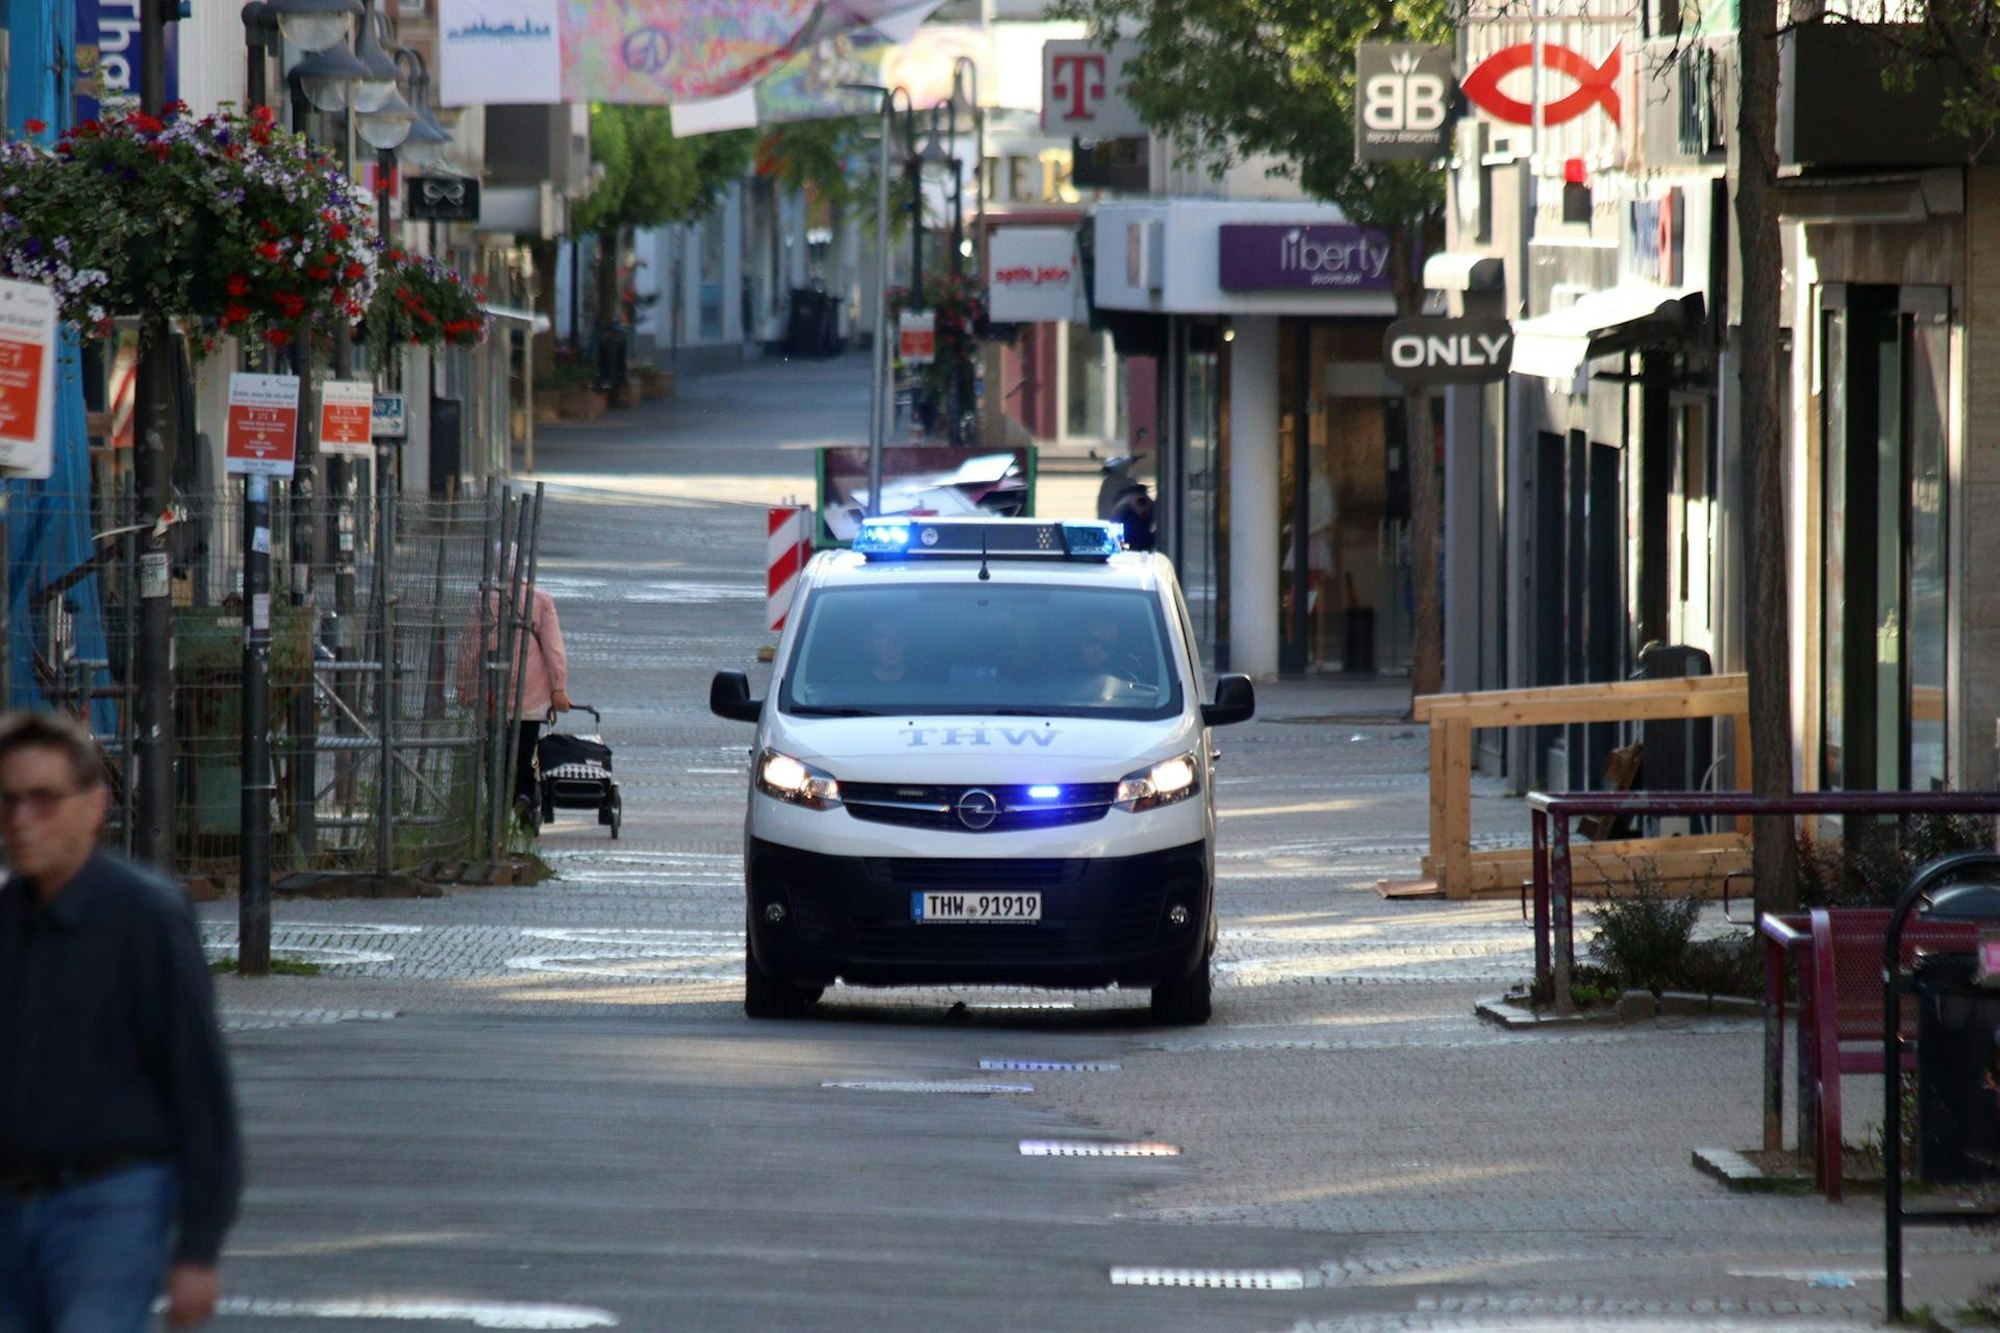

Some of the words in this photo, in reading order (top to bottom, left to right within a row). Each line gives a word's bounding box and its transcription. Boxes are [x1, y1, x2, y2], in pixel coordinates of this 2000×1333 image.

[1053, 54, 1105, 120] T
[1281, 230, 1391, 278] liberty
[1311, 272, 1362, 286] woman
[1391, 334, 1509, 368] ONLY
[898, 728, 1064, 747] THW
[928, 896, 964, 916] THW
[979, 896, 1037, 916] 91919
